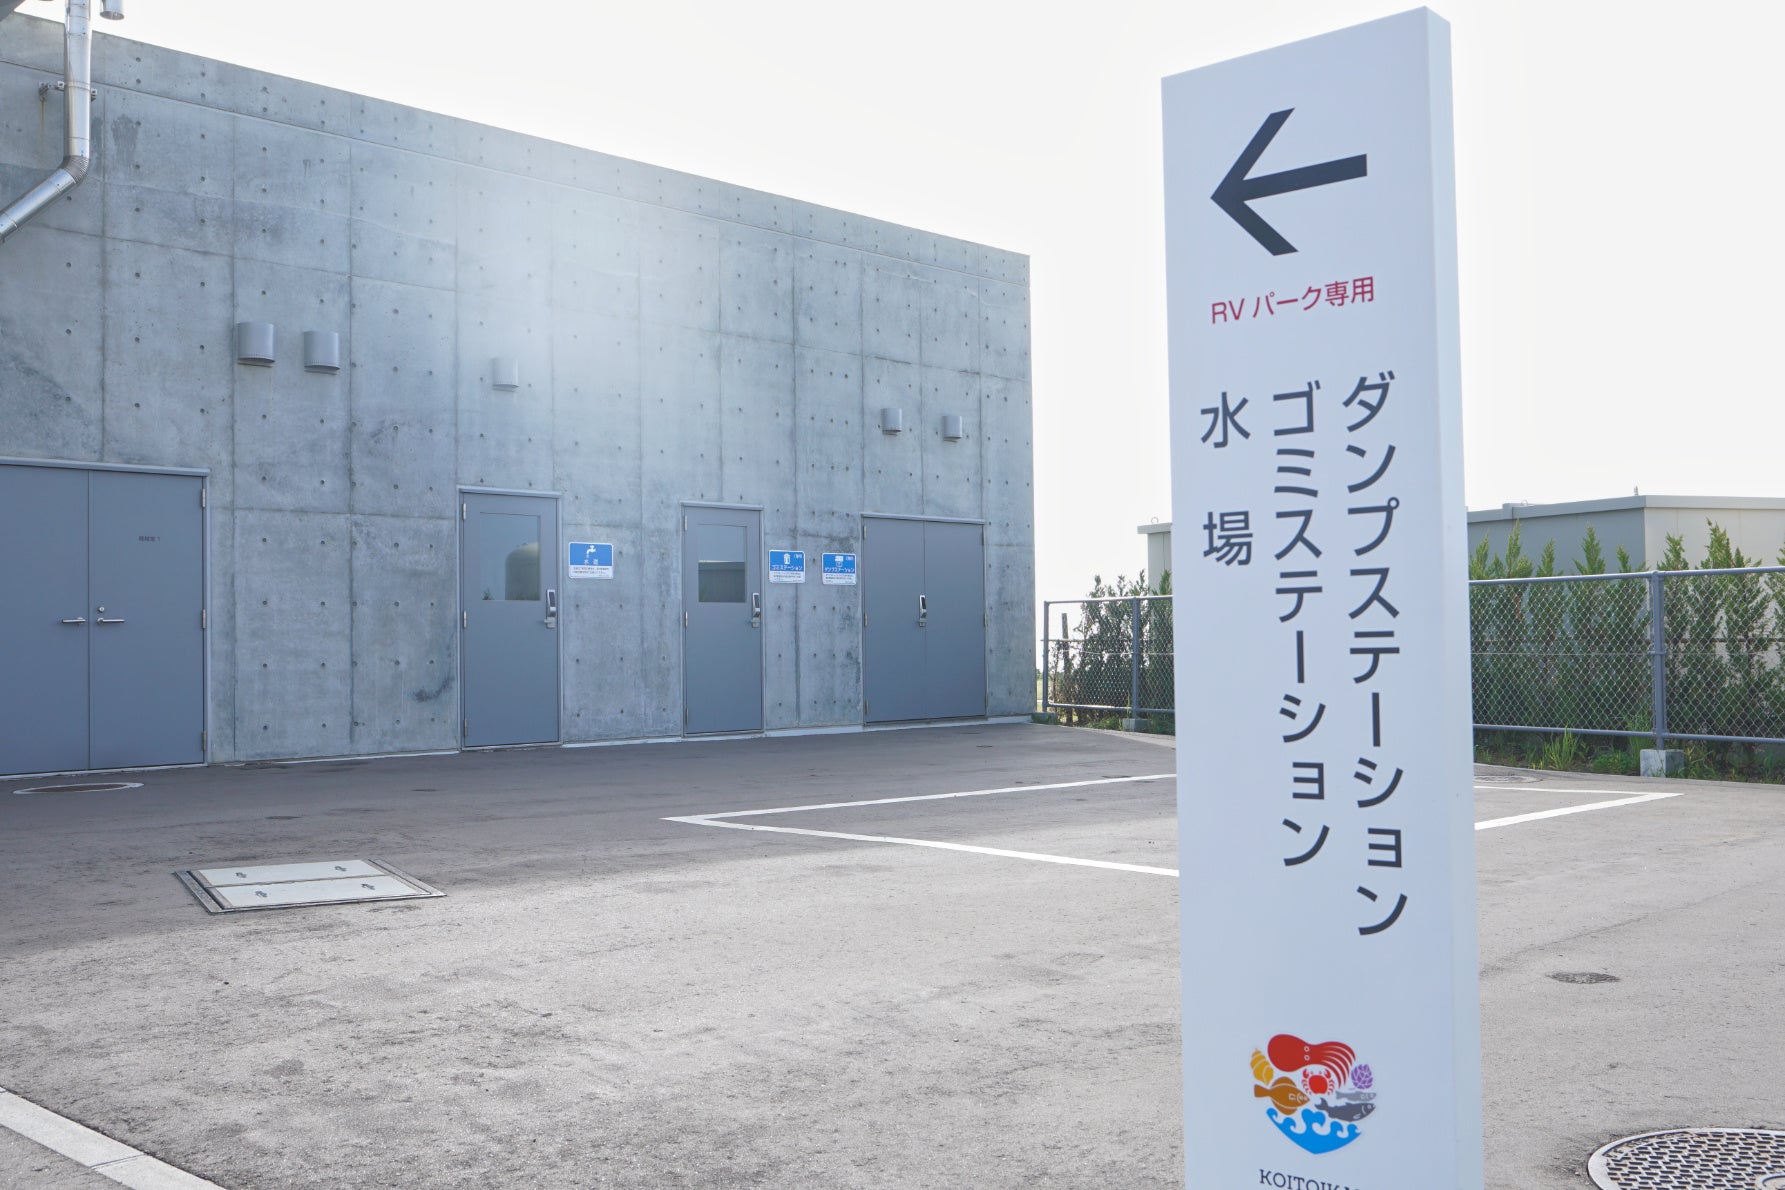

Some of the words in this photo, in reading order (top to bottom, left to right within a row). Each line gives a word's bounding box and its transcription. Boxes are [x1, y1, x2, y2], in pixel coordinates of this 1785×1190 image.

[1272, 379, 1330, 867] ゴミステーション
[1342, 370, 1408, 936] ダンプステーション
